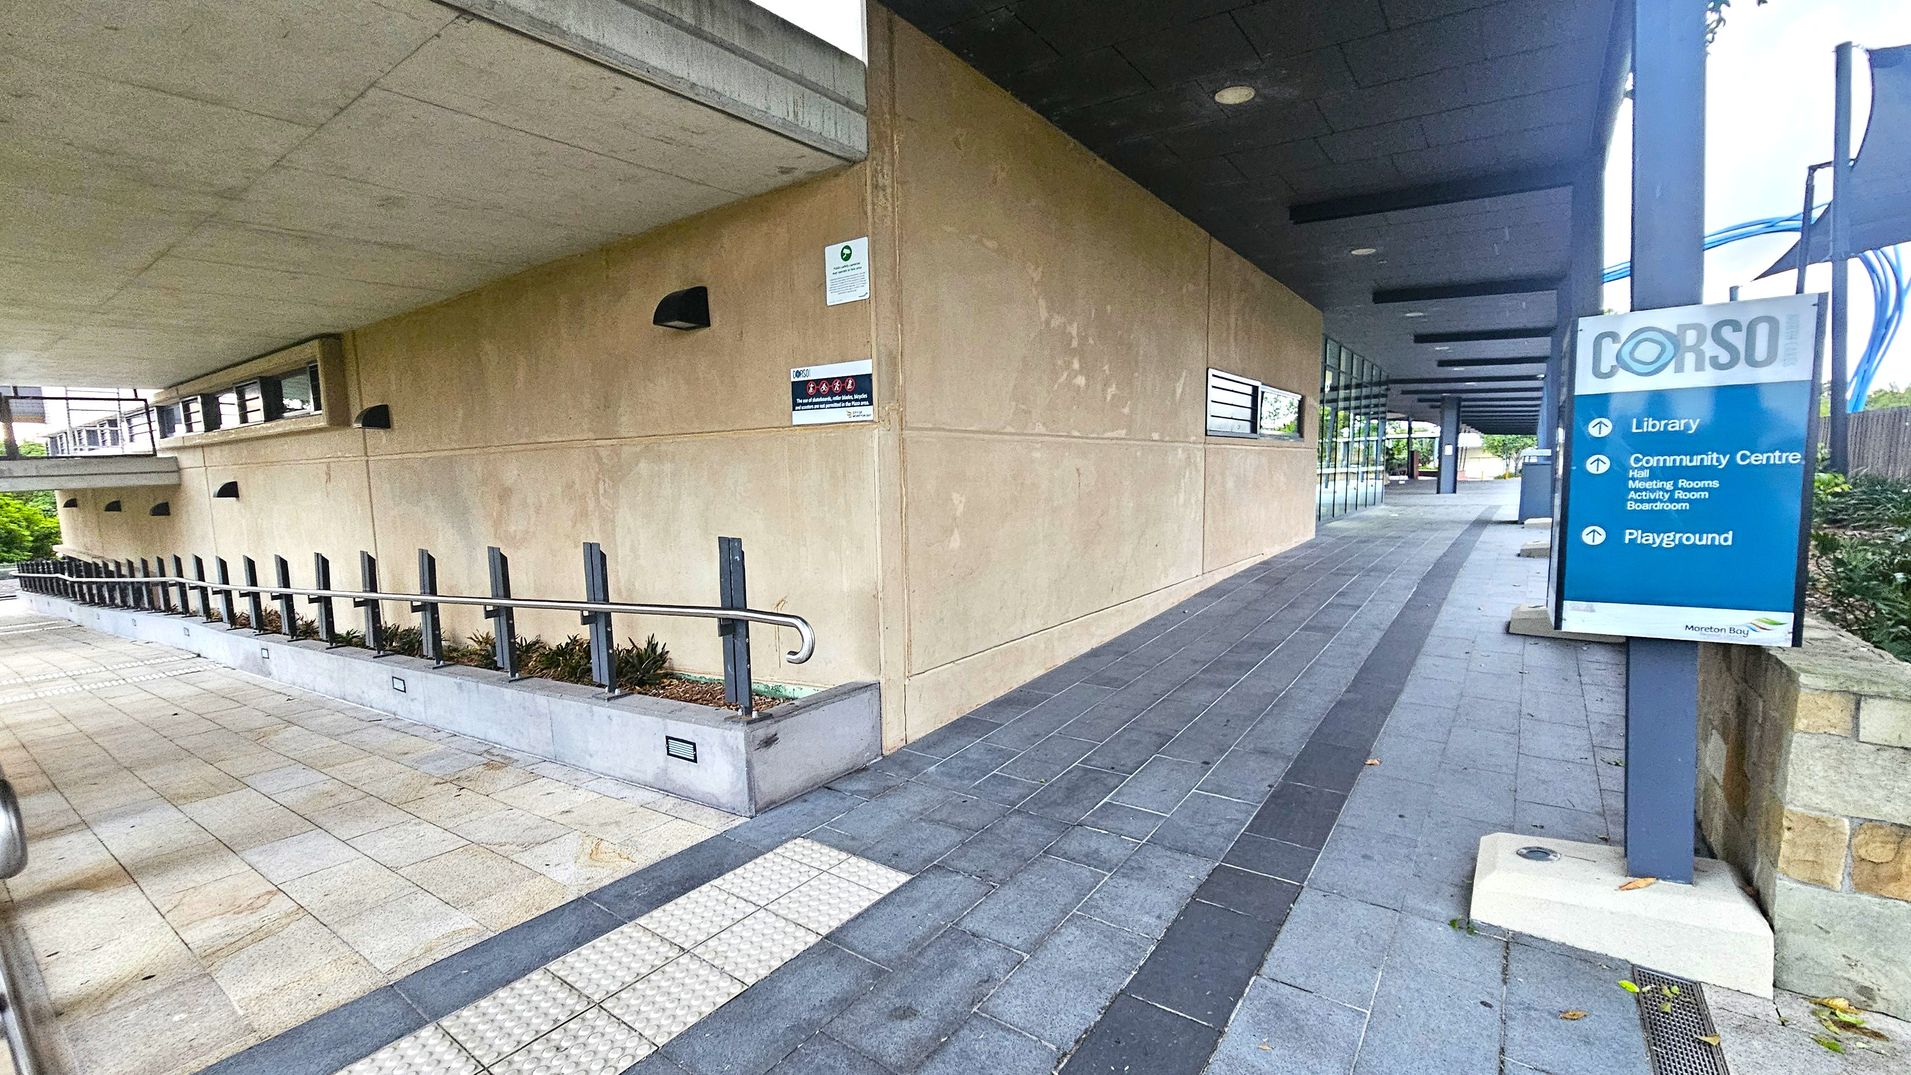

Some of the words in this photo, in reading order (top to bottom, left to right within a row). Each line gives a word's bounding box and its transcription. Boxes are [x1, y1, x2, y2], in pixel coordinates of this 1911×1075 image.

[1591, 315, 1780, 380] CORSO
[1631, 417, 1700, 434] Library
[1629, 451, 1730, 469] Community
[1736, 450, 1802, 465] Centre
[1628, 468, 1650, 478] Hall
[1628, 479, 1674, 490] Meeting
[1678, 478, 1720, 489] Rooms
[1628, 490, 1670, 501] Activity
[1674, 490, 1709, 500] Room
[1627, 501, 1690, 511] Boardroom
[1624, 529, 1733, 548] Playground
[1684, 623, 1727, 635] Moreton
[1728, 626, 1750, 639] Bay
